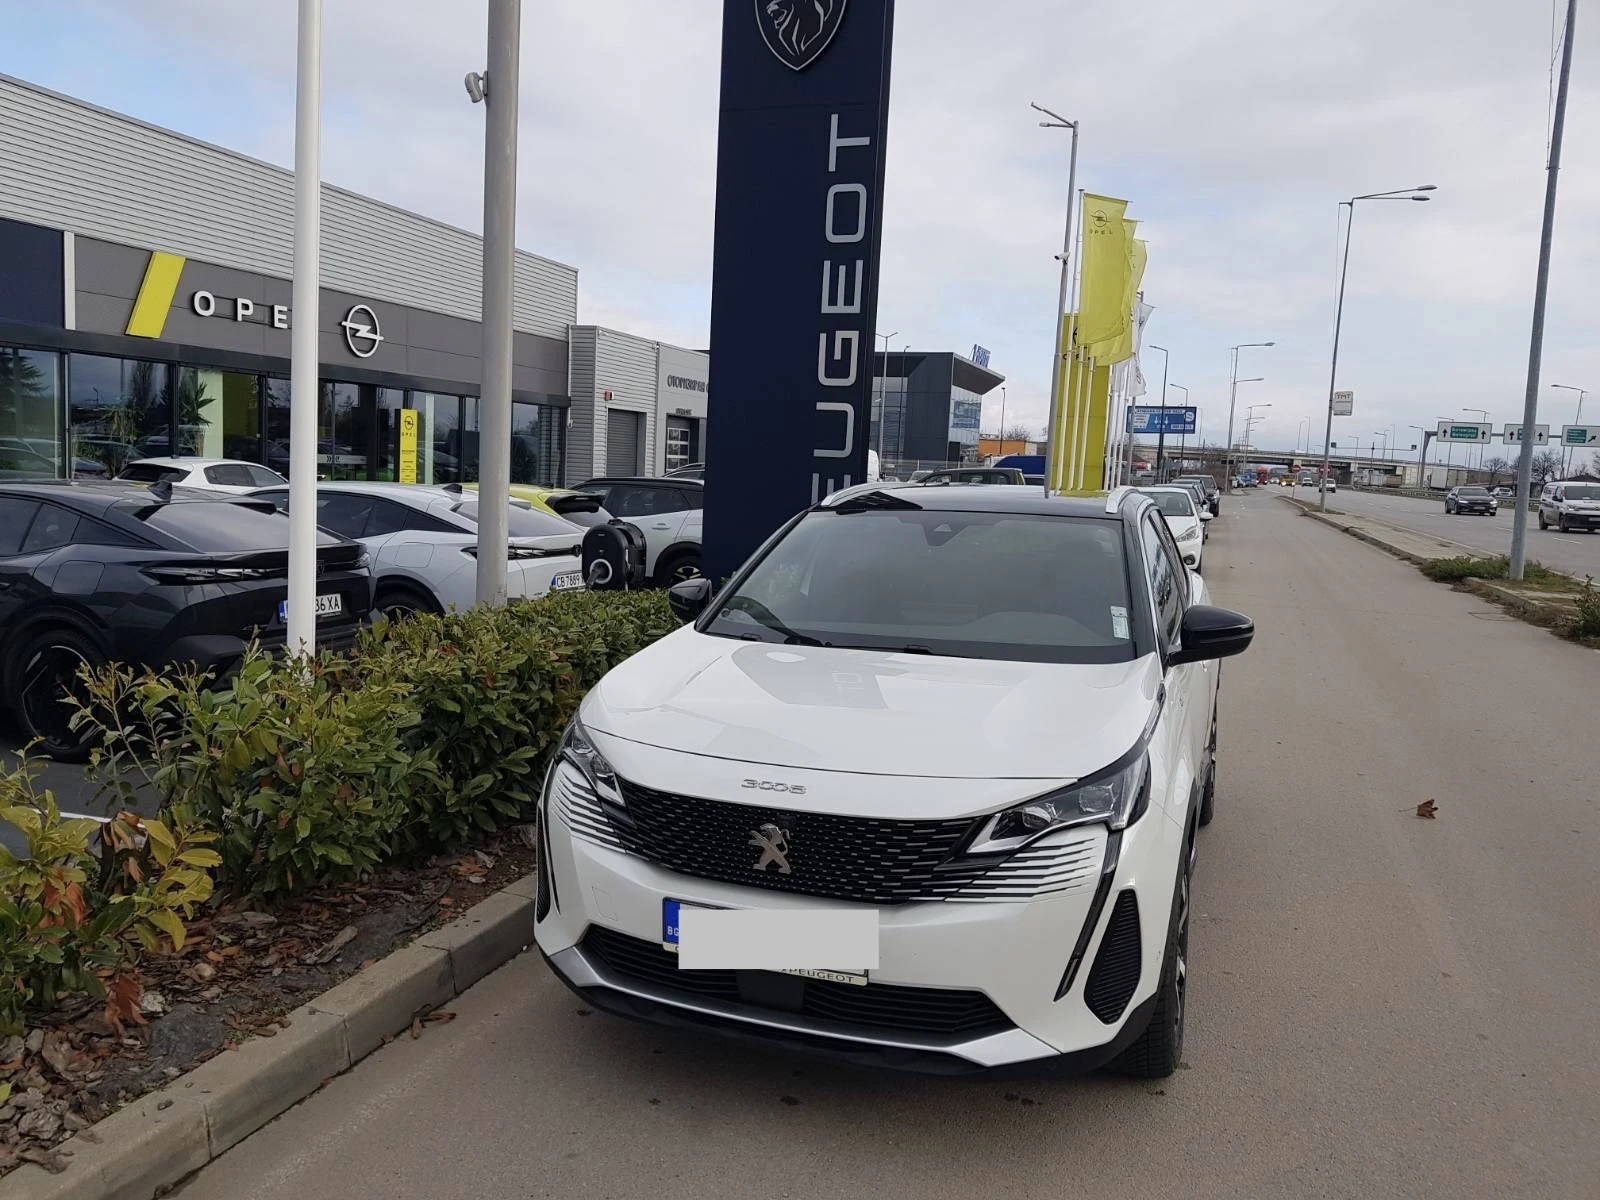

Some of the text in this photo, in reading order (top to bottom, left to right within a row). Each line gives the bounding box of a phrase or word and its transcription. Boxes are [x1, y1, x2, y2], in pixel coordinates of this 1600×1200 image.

[193, 290, 290, 329] OPE
[811, 113, 870, 505] UGEOT
[327, 595, 340, 611] XA
[667, 926, 679, 937] BG
